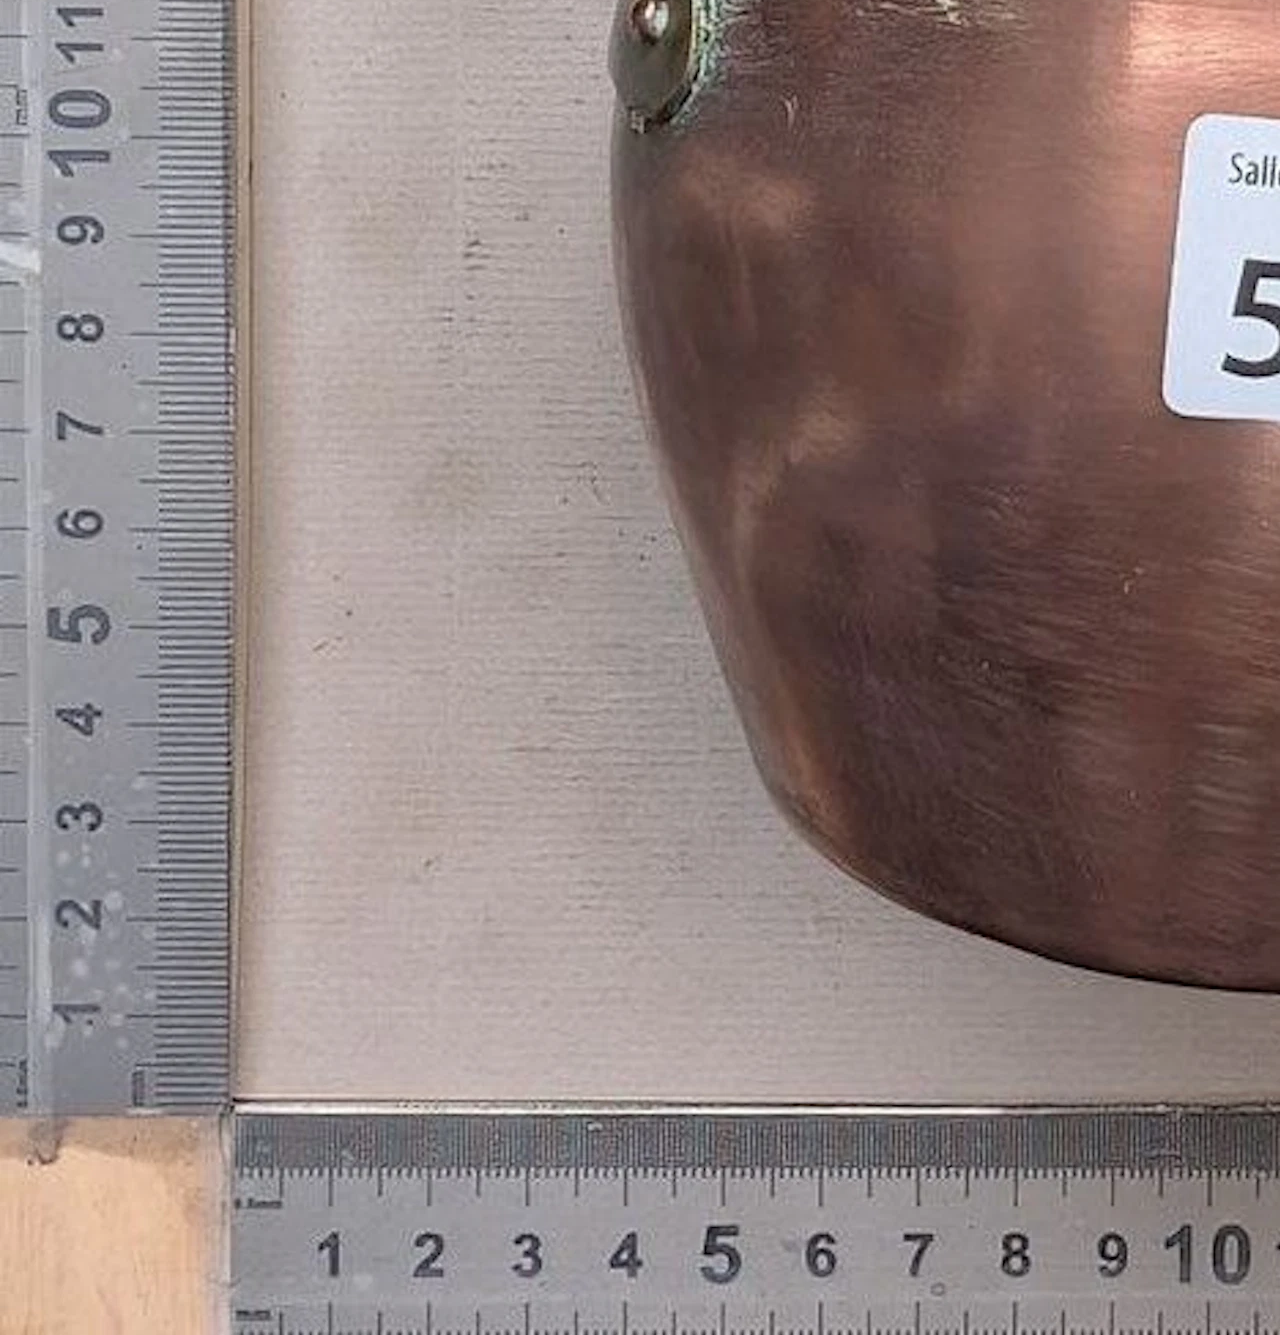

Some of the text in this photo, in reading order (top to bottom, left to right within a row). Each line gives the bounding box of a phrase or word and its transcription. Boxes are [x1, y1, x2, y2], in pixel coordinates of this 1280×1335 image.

[55, 8, 104, 64] 11
[47, 90, 111, 177] 10
[57, 216, 104, 245] 9
[57, 314, 104, 343] 8
[57, 411, 103, 440] 7
[56, 510, 103, 539] 6
[47, 605, 112, 645] 5
[55, 703, 103, 736] 4
[56, 803, 103, 831] 3
[55, 900, 102, 930] 2
[53, 1004, 101, 1025] 1
[318, 1232, 340, 1277] 1
[413, 1232, 444, 1278] 2
[512, 1233, 542, 1278] 3
[609, 1232, 643, 1277] 4
[701, 1225, 742, 1284] 5
[806, 1233, 837, 1277] 6
[904, 1234, 934, 1277] 7
[1001, 1233, 1031, 1277] 8
[1098, 1233, 1127, 1277] 9
[1164, 1224, 1251, 1284] 10
